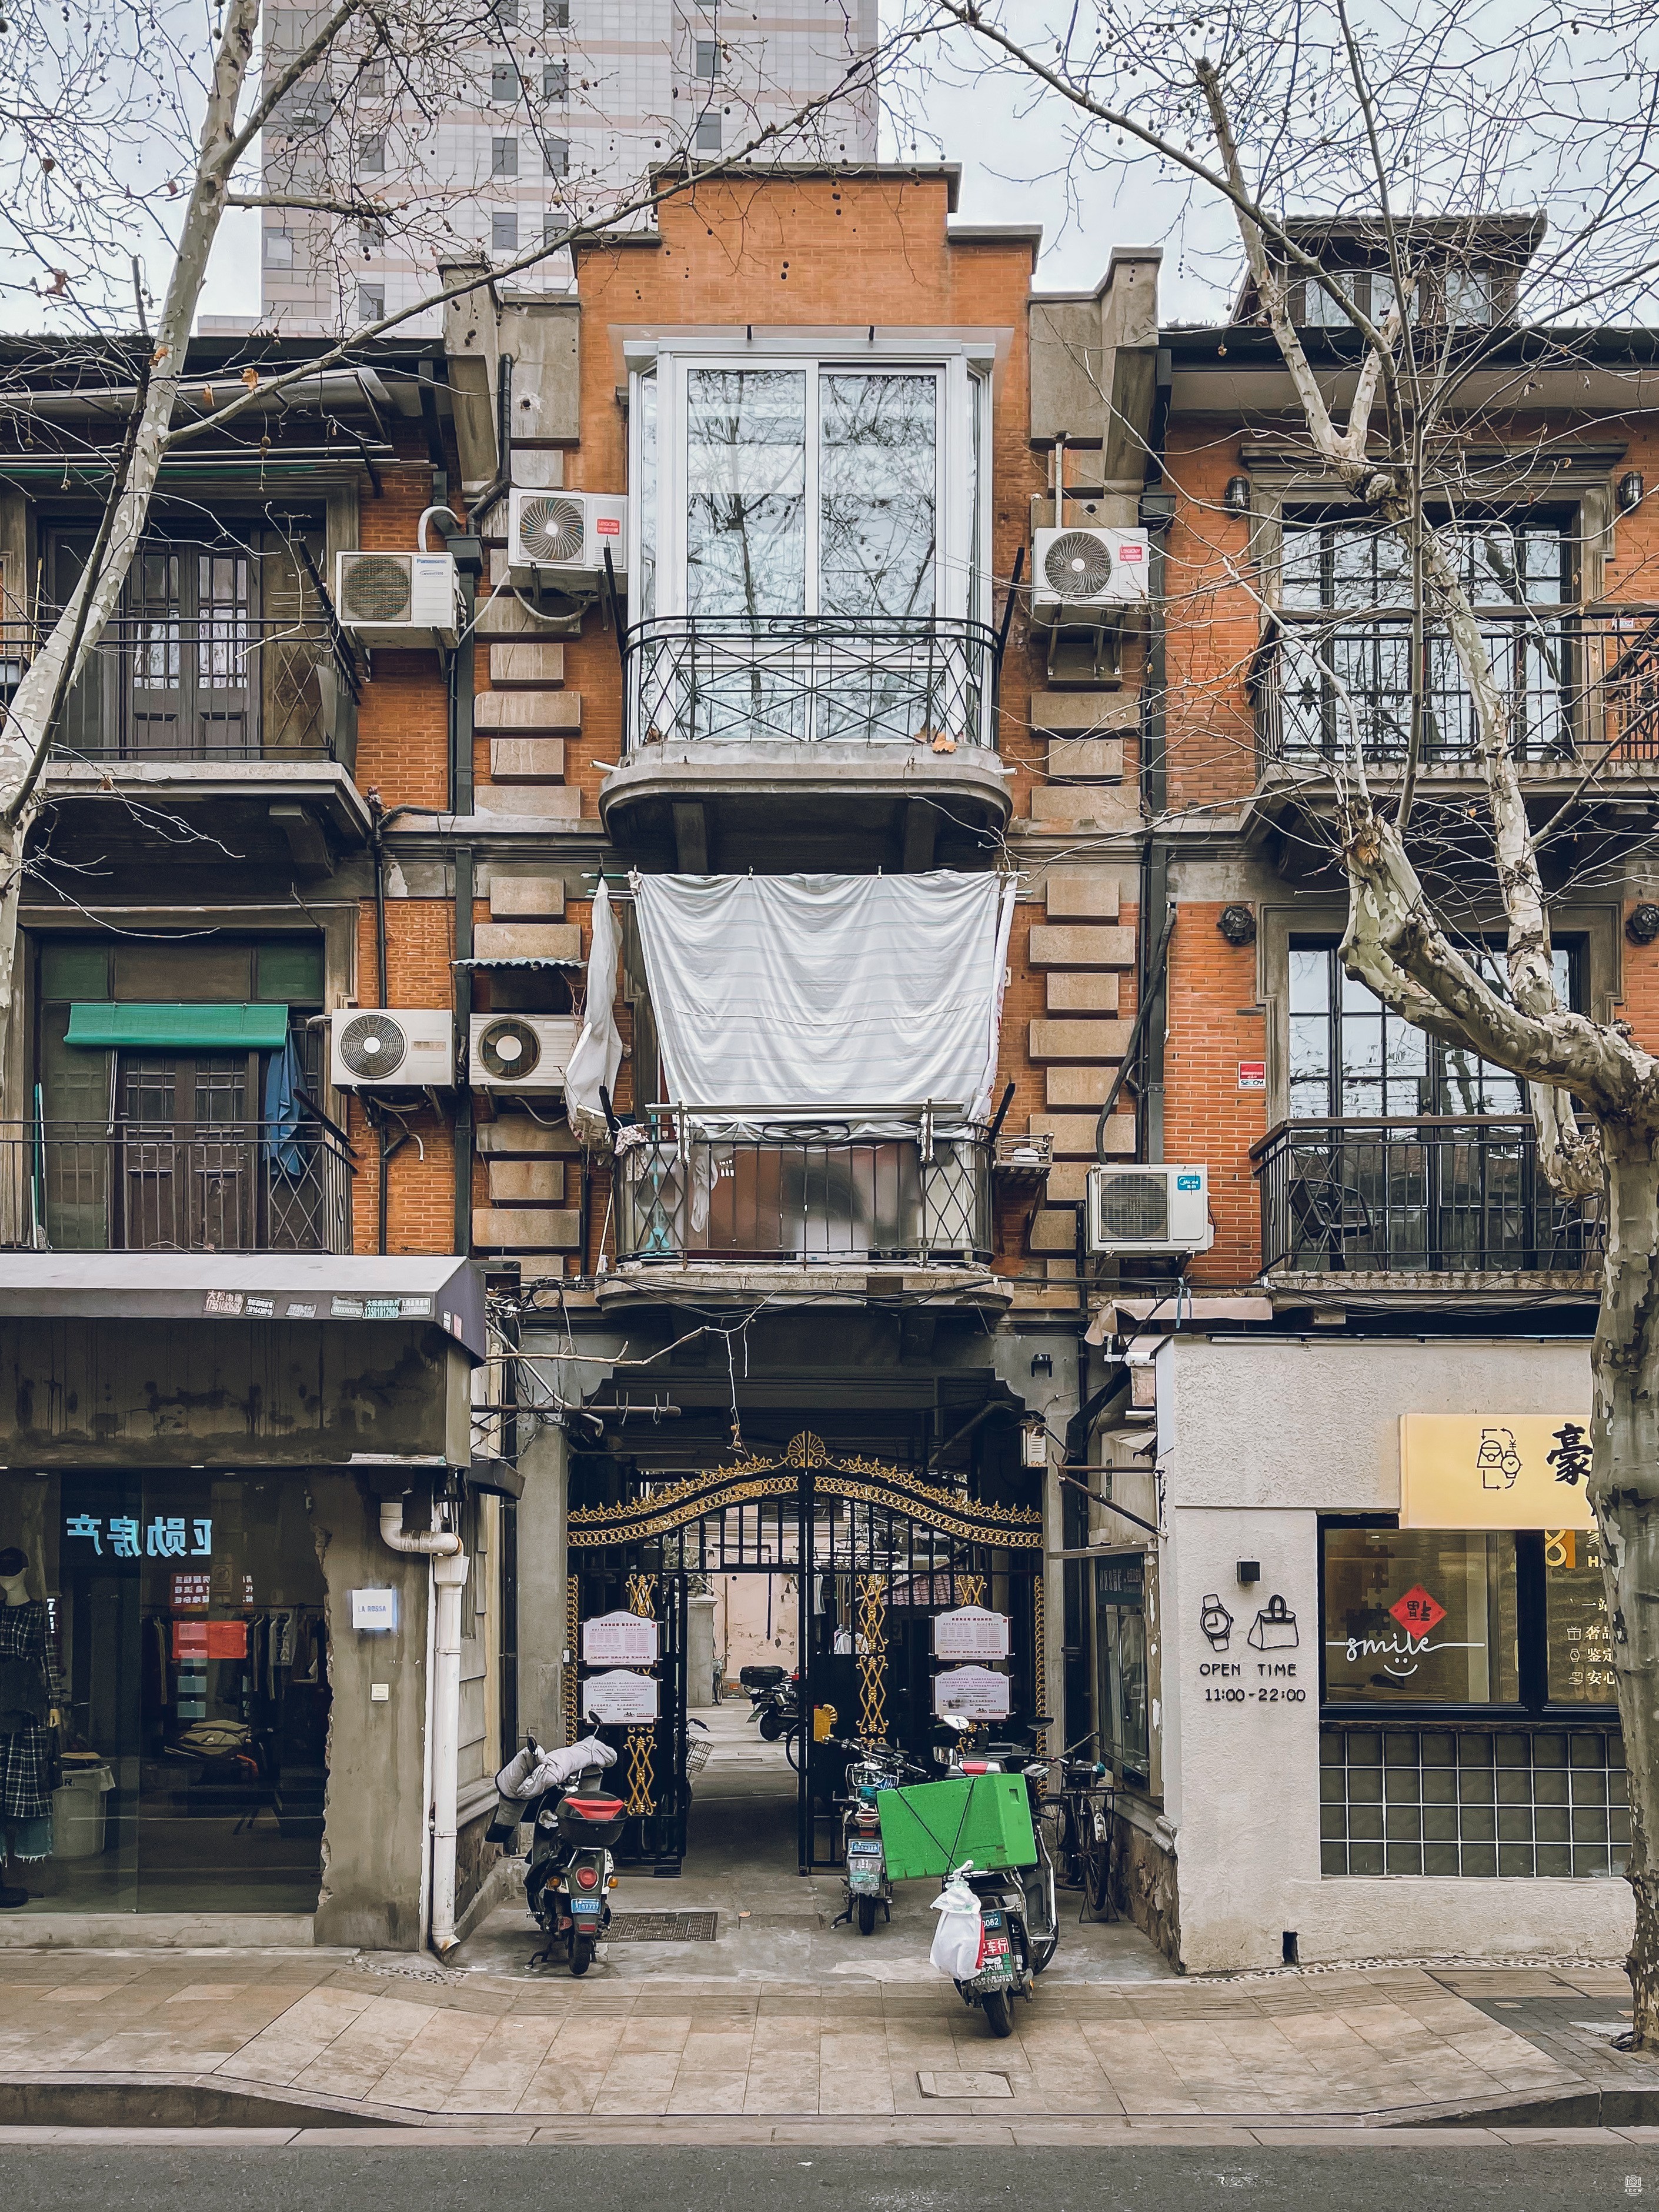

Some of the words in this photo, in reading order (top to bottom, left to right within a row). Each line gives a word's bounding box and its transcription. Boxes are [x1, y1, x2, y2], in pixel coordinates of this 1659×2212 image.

[1346, 1631, 1447, 1661] smile
[1199, 1663, 1241, 1677] OPEN
[1257, 1663, 1297, 1677] TIME
[1587, 1670, 1616, 1685] 安心
